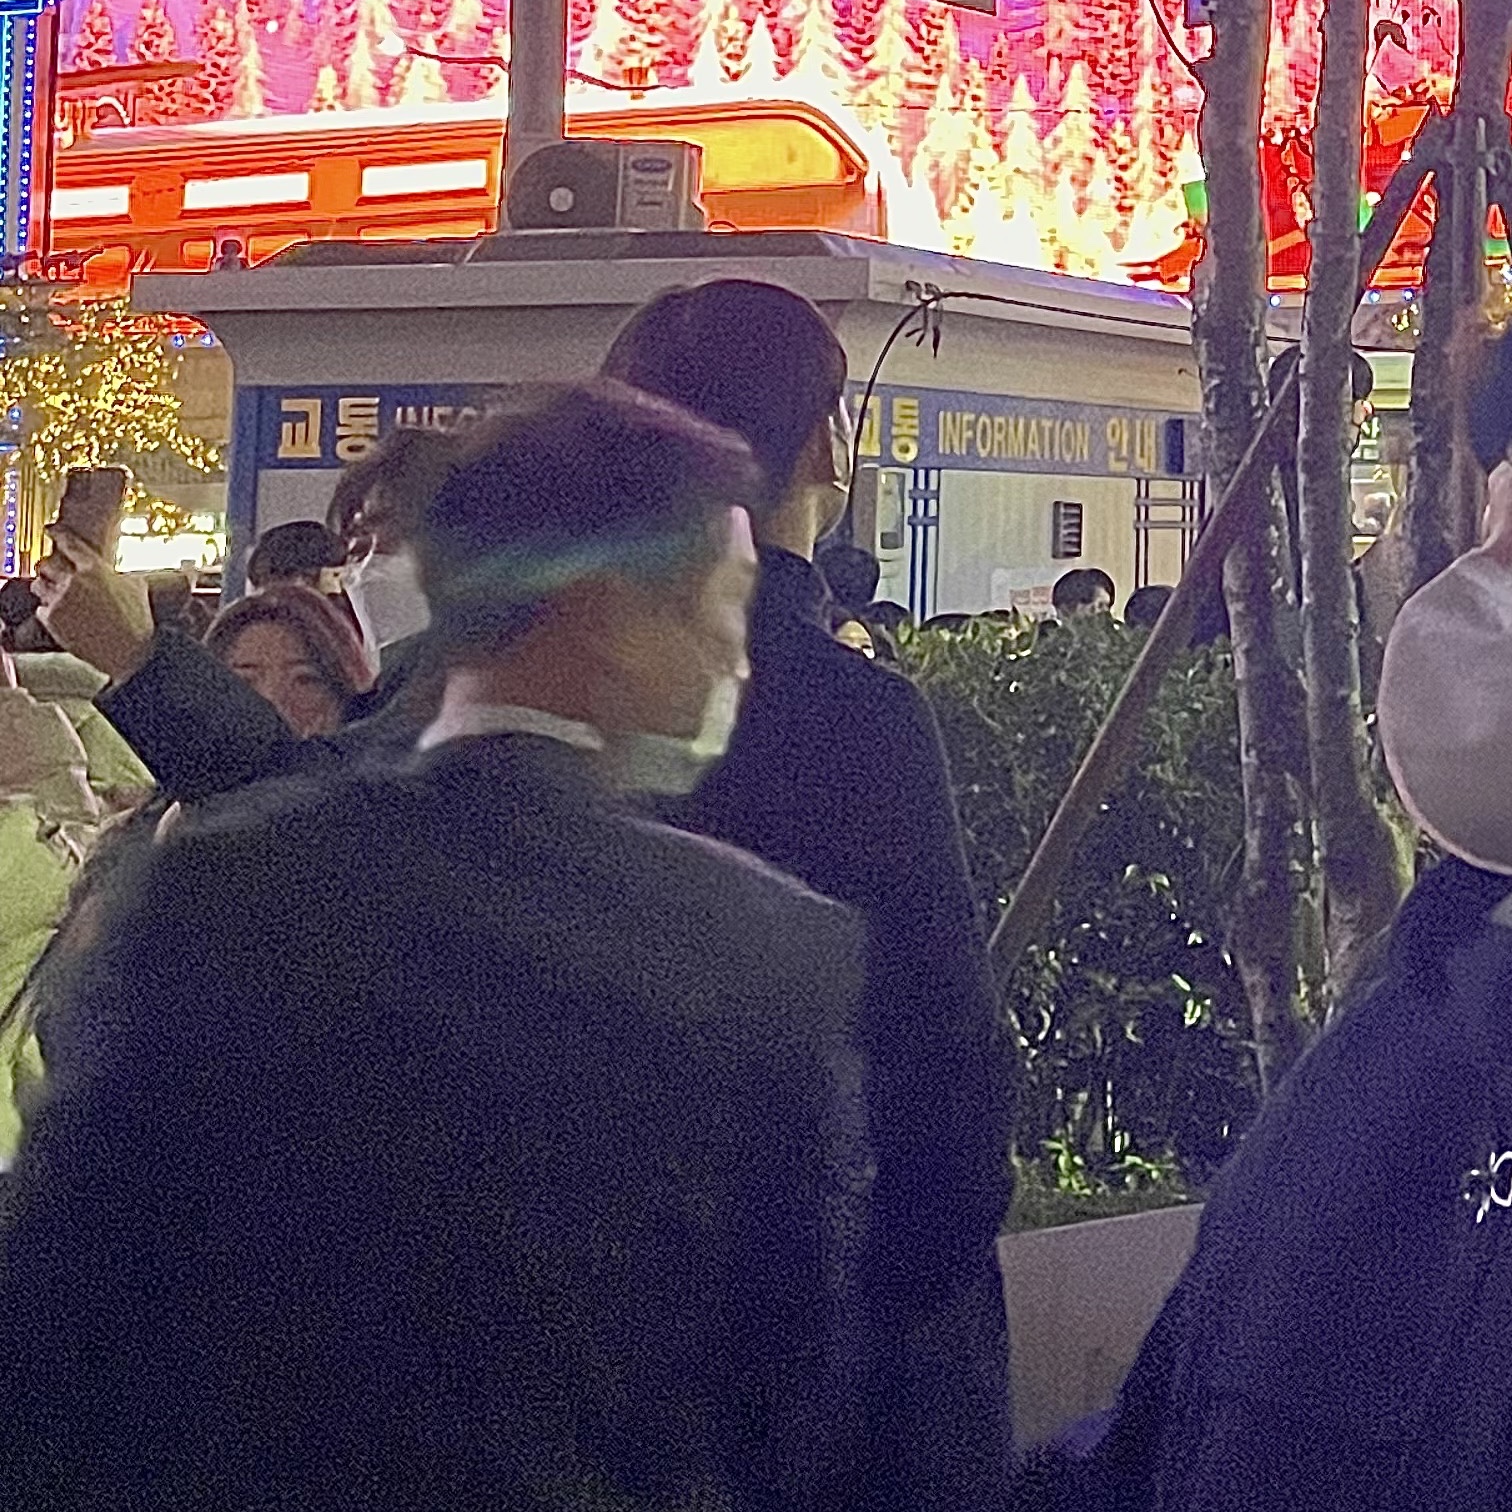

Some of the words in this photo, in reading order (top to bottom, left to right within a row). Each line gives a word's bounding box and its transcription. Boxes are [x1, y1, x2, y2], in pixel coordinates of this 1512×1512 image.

[277, 397, 380, 462] 교통
[854, 393, 919, 464] 교통
[938, 410, 1090, 461] INFORMATION
[1106, 416, 1157, 473] 안내
